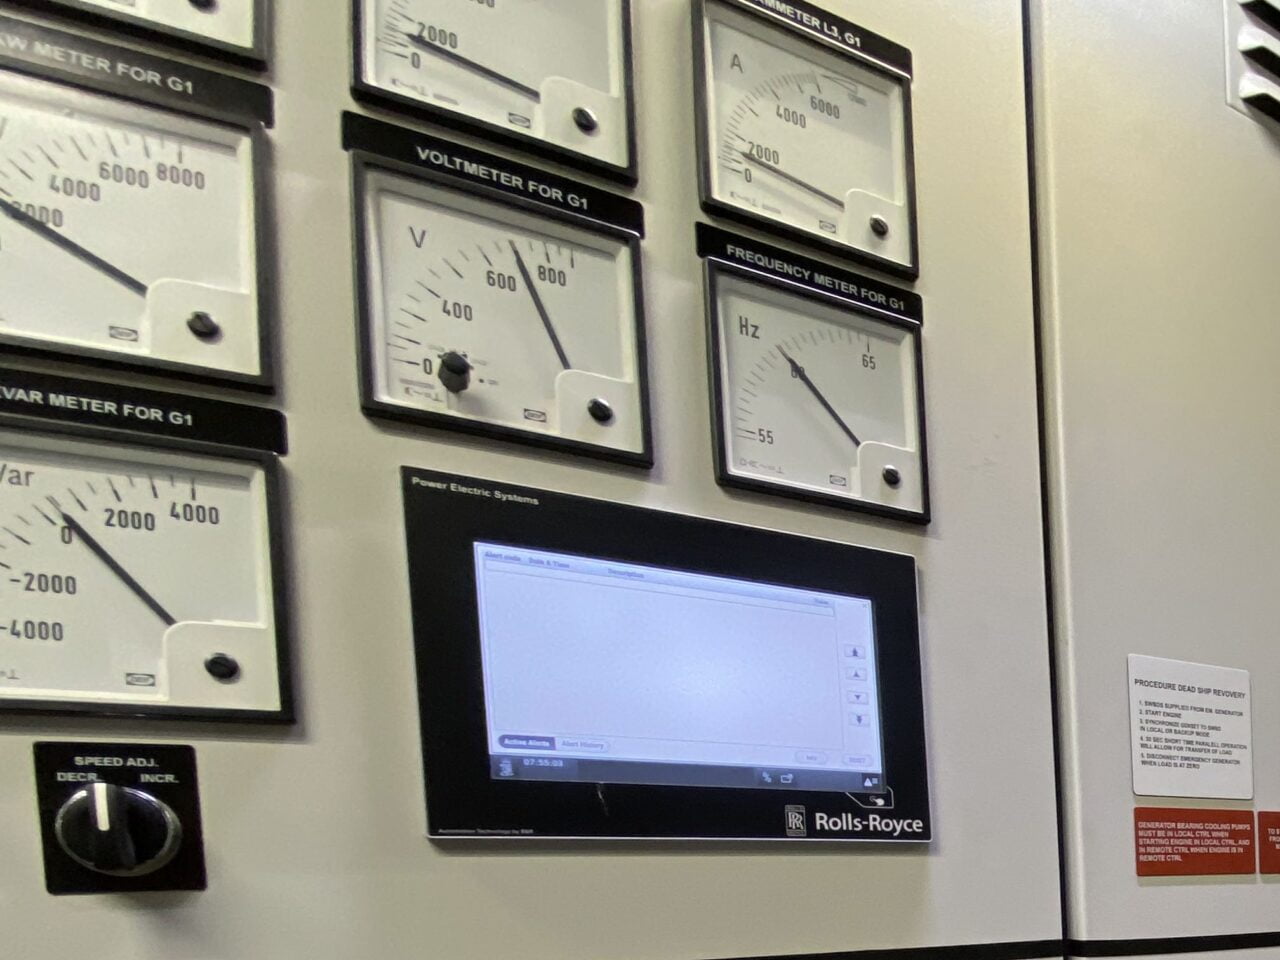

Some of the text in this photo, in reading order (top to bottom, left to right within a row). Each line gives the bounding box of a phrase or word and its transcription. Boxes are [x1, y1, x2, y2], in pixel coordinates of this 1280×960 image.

[416, 22, 458, 49] 2000
[823, 21, 842, 41] L3,
[844, 32, 861, 48] G1
[34, 41, 111, 73] METER
[116, 62, 163, 88] FOR
[167, 76, 193, 95] G1
[411, 52, 421, 69] 0
[730, 54, 744, 74] A
[776, 105, 807, 129] 4000
[810, 95, 840, 119] 6000
[748, 141, 780, 165] 2000
[99, 161, 149, 189] 6000
[156, 162, 206, 190] 8000
[416, 146, 588, 210] VOLTMETER FOR G1
[744, 168, 752, 183] 0
[50, 174, 101, 202] 4000
[409, 225, 427, 249] V
[486, 269, 517, 292] 600
[538, 264, 567, 287] 800
[726, 244, 905, 312] FREQUENCY METER FOR G1
[442, 299, 473, 321] 400
[738, 315, 760, 340] Hz
[422, 357, 433, 376] 0
[861, 354, 876, 370] 65
[0, 387, 193, 427] VAR METER FOR G1
[757, 428, 774, 445] 55
[412, 476, 539, 505] Power Electric Systems
[104, 507, 156, 531] 2000
[169, 501, 220, 525] 4000
[61, 526, 73, 544] 0
[10, 572, 77, 595] -2000
[0, 620, 64, 641] -4000
[1134, 679, 1176, 691] PROCEDURE
[1178, 684, 1196, 694] DEAD
[1197, 687, 1212, 695] SHIP
[74, 756, 160, 768] SPEED ADJ.
[56, 772, 104, 783] DECR.
[140, 773, 180, 784] INCR.
[815, 812, 924, 836] Rolls-Royce
[1138, 821, 1176, 829] GENERATOR
[1177, 822, 1204, 830] BEARING
[1204, 823, 1230, 831] COOLING
[1174, 830, 1194, 838] LOCAL
